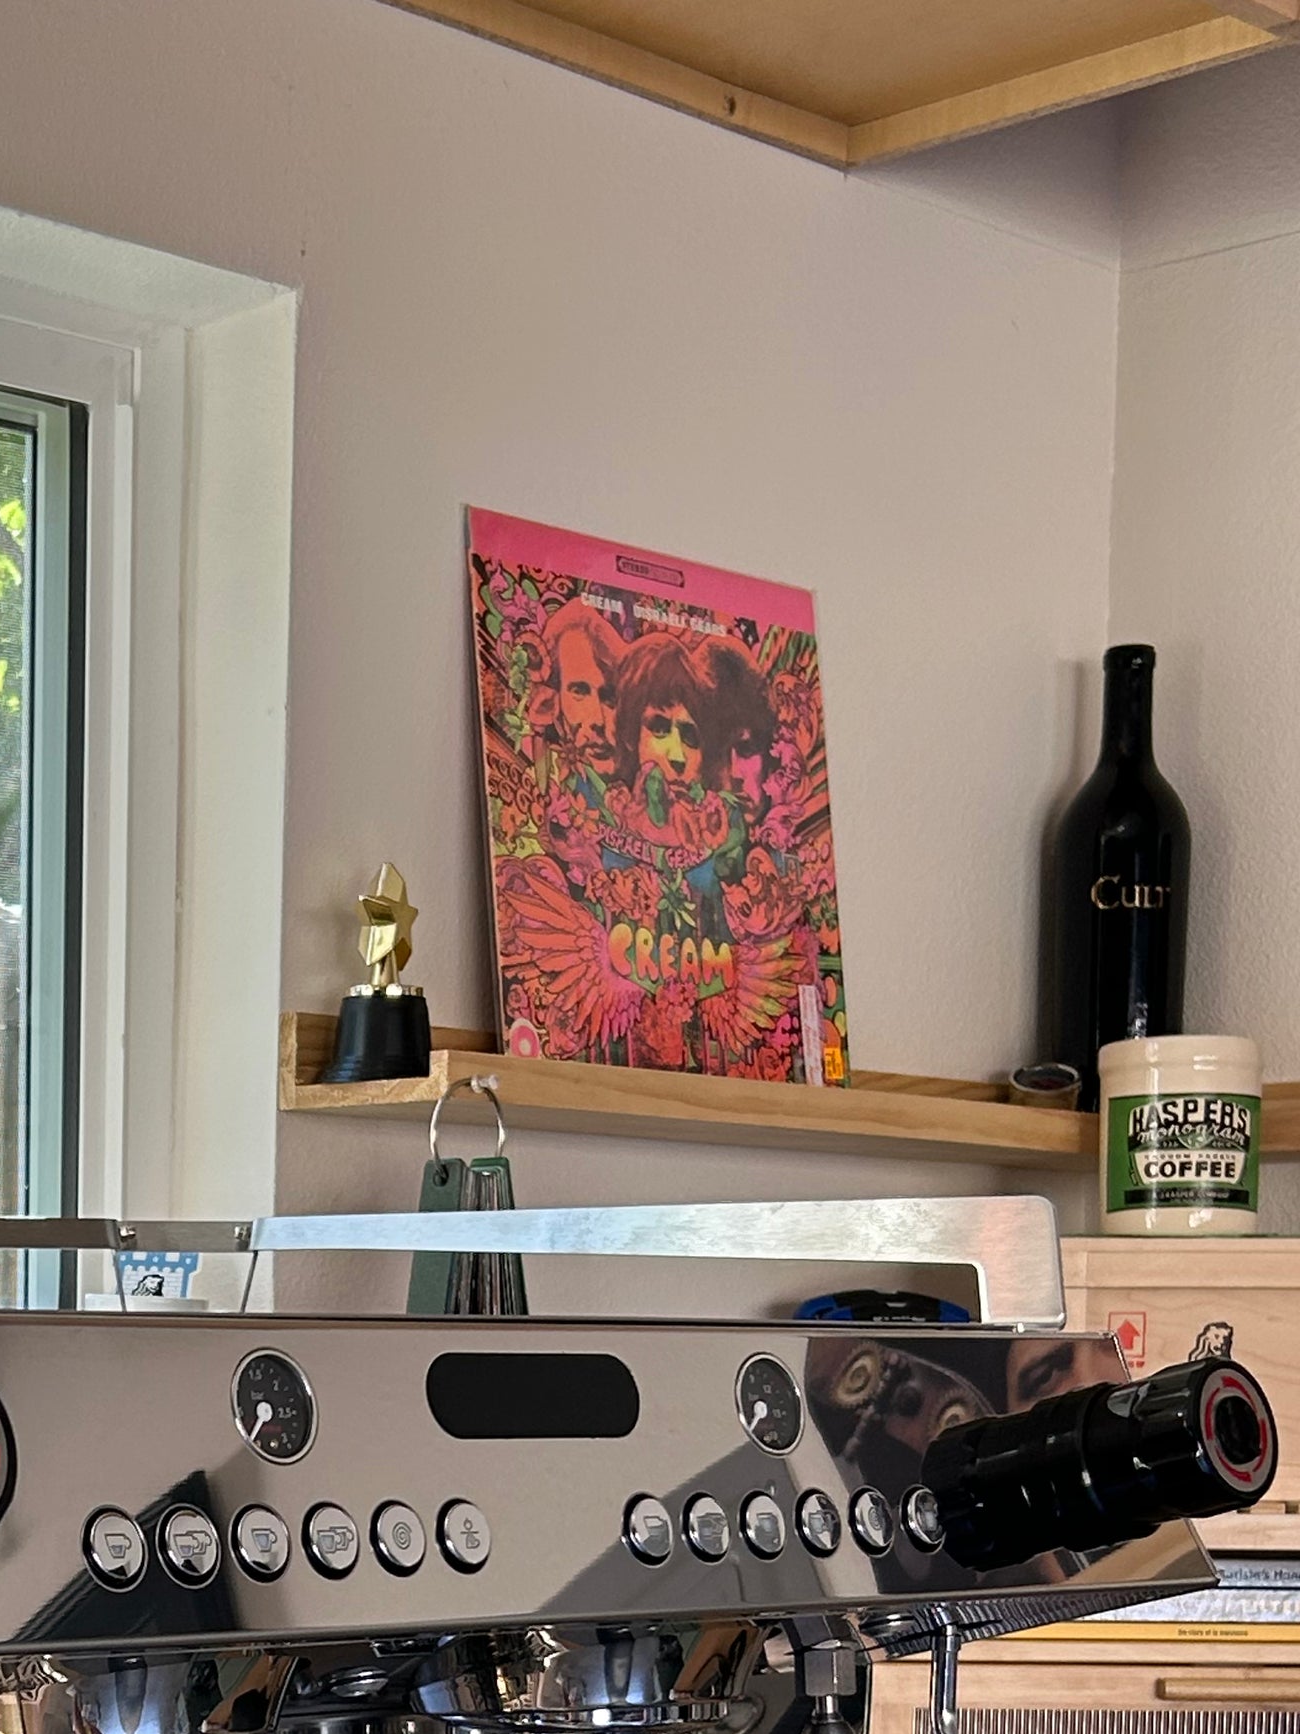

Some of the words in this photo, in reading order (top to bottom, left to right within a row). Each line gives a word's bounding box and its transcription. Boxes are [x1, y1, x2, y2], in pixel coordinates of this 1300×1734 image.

[580, 592, 622, 614] CREAM
[633, 604, 686, 628] DISRAELI
[689, 616, 727, 637] GEARS
[609, 922, 737, 988] CREAM
[1143, 1161, 1236, 1179] COFFEE
